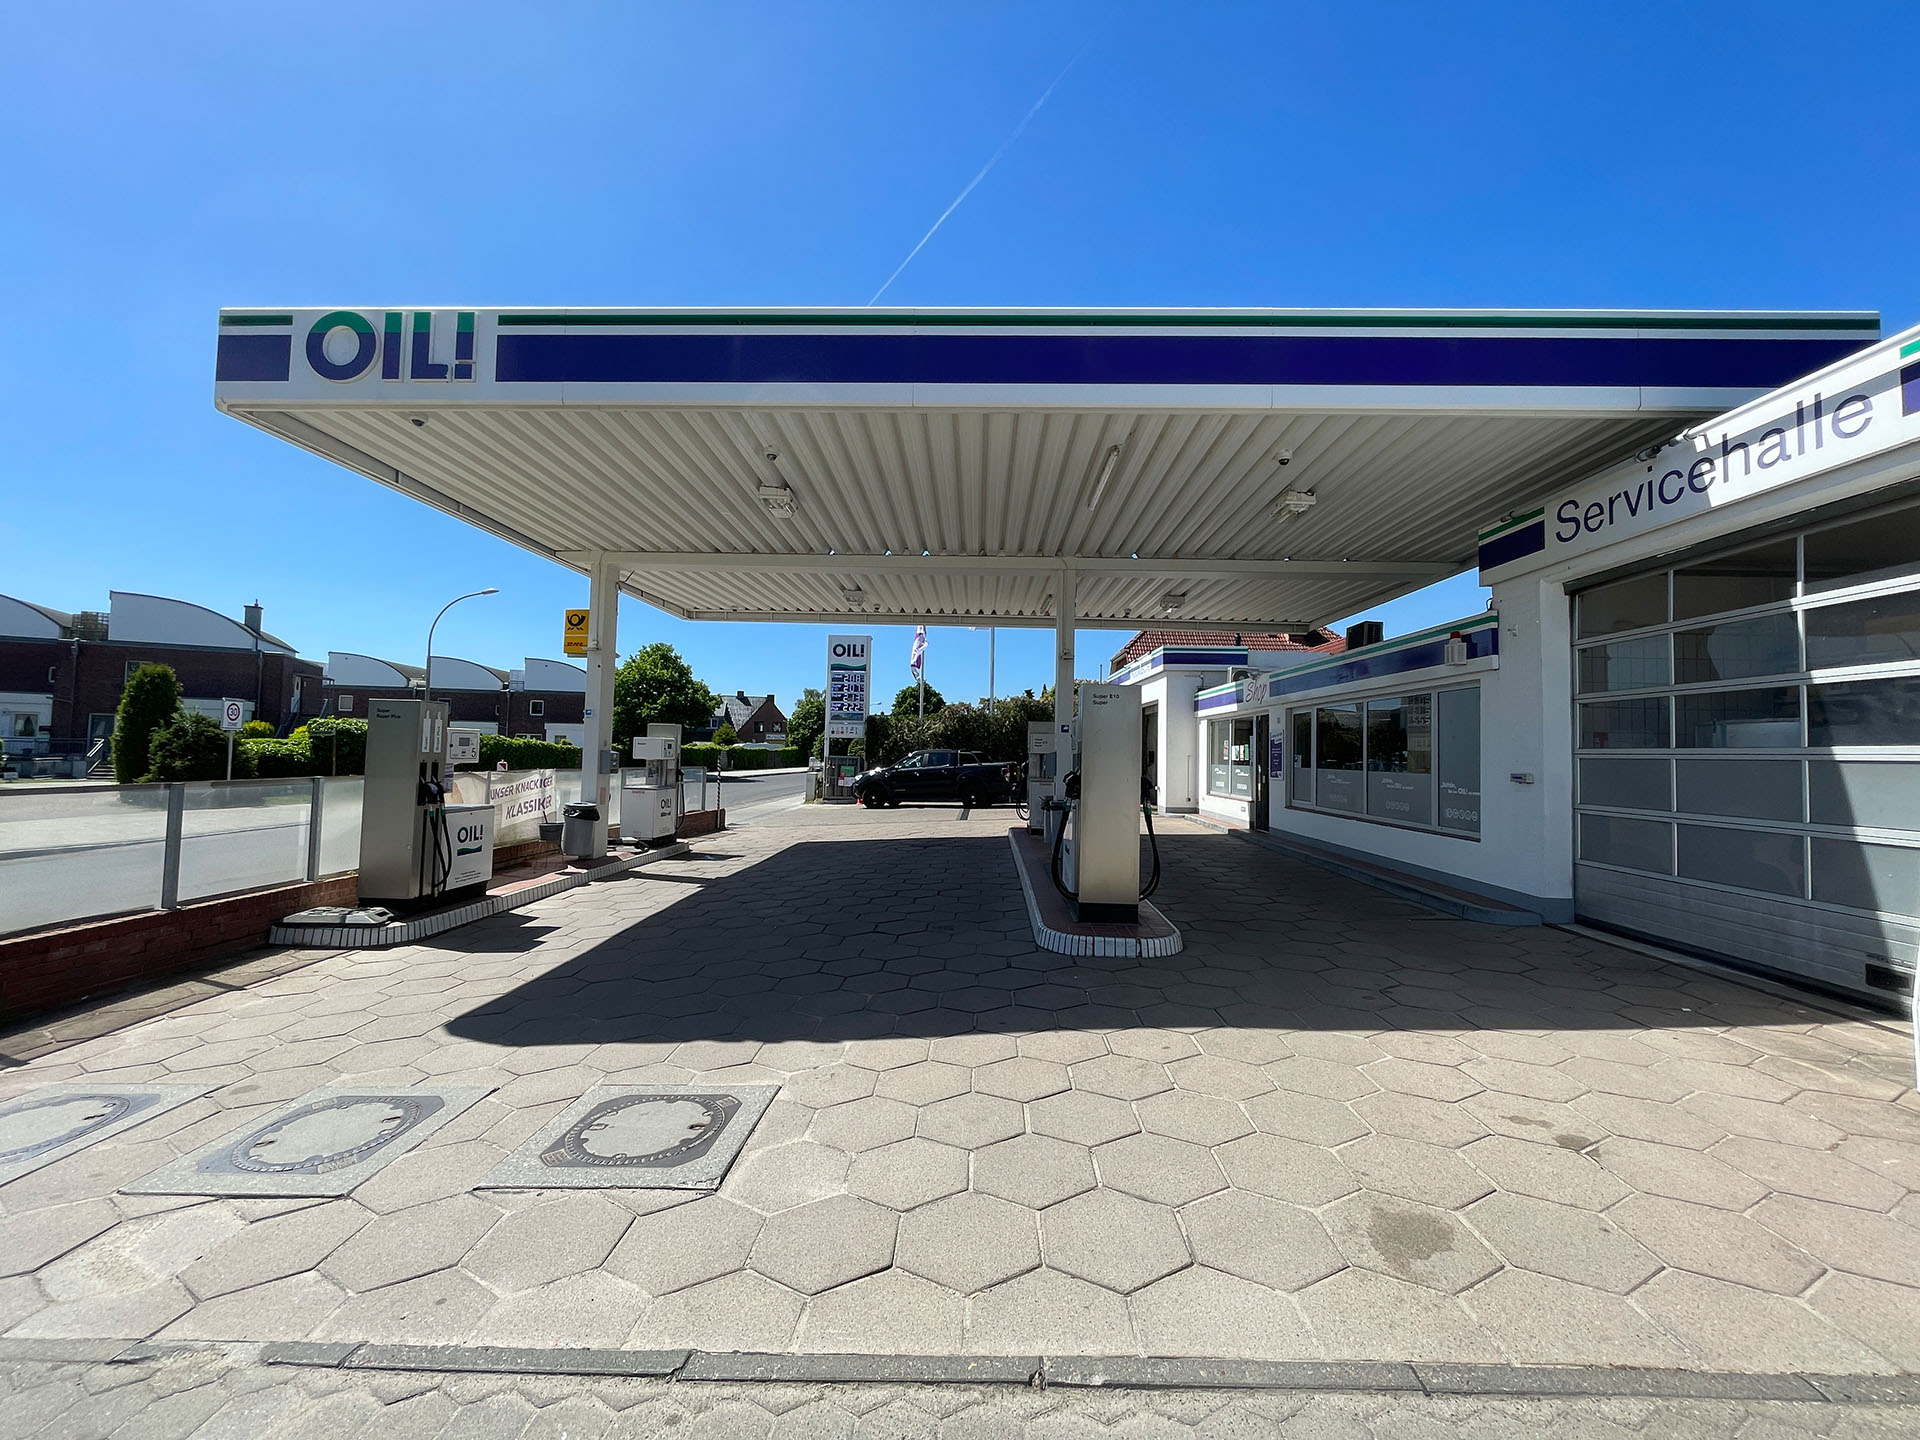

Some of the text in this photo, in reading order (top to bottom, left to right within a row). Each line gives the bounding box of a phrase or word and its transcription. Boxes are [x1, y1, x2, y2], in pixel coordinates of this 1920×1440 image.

[306, 311, 477, 381] OIL!
[1555, 392, 1873, 543] Servicehalle
[832, 643, 865, 657] OIL!
[1246, 679, 1267, 704] Shop
[230, 707, 237, 716] 30
[471, 748, 477, 757] 5
[491, 785, 514, 800] UNSER
[506, 795, 552, 819] KLASSIKER
[457, 824, 484, 843] OIL!
